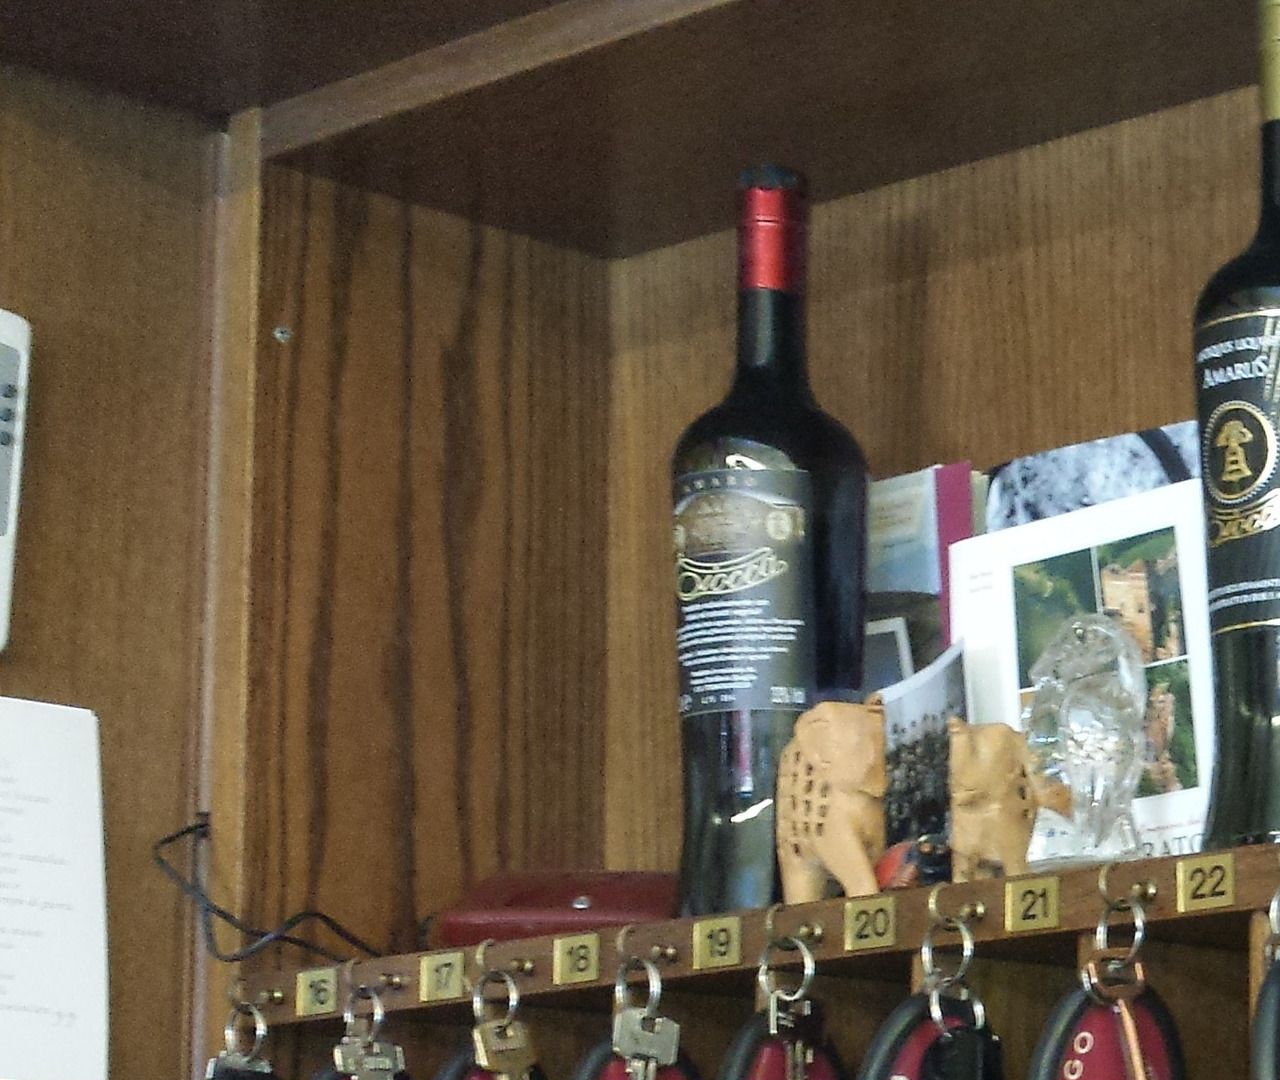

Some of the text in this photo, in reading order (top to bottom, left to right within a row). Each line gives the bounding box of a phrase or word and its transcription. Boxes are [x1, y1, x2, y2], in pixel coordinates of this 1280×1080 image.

[1189, 865, 1227, 900] 22
[1021, 888, 1051, 921] 21
[854, 907, 890, 940] 20
[566, 943, 590, 973] 18
[706, 927, 729, 957] 19
